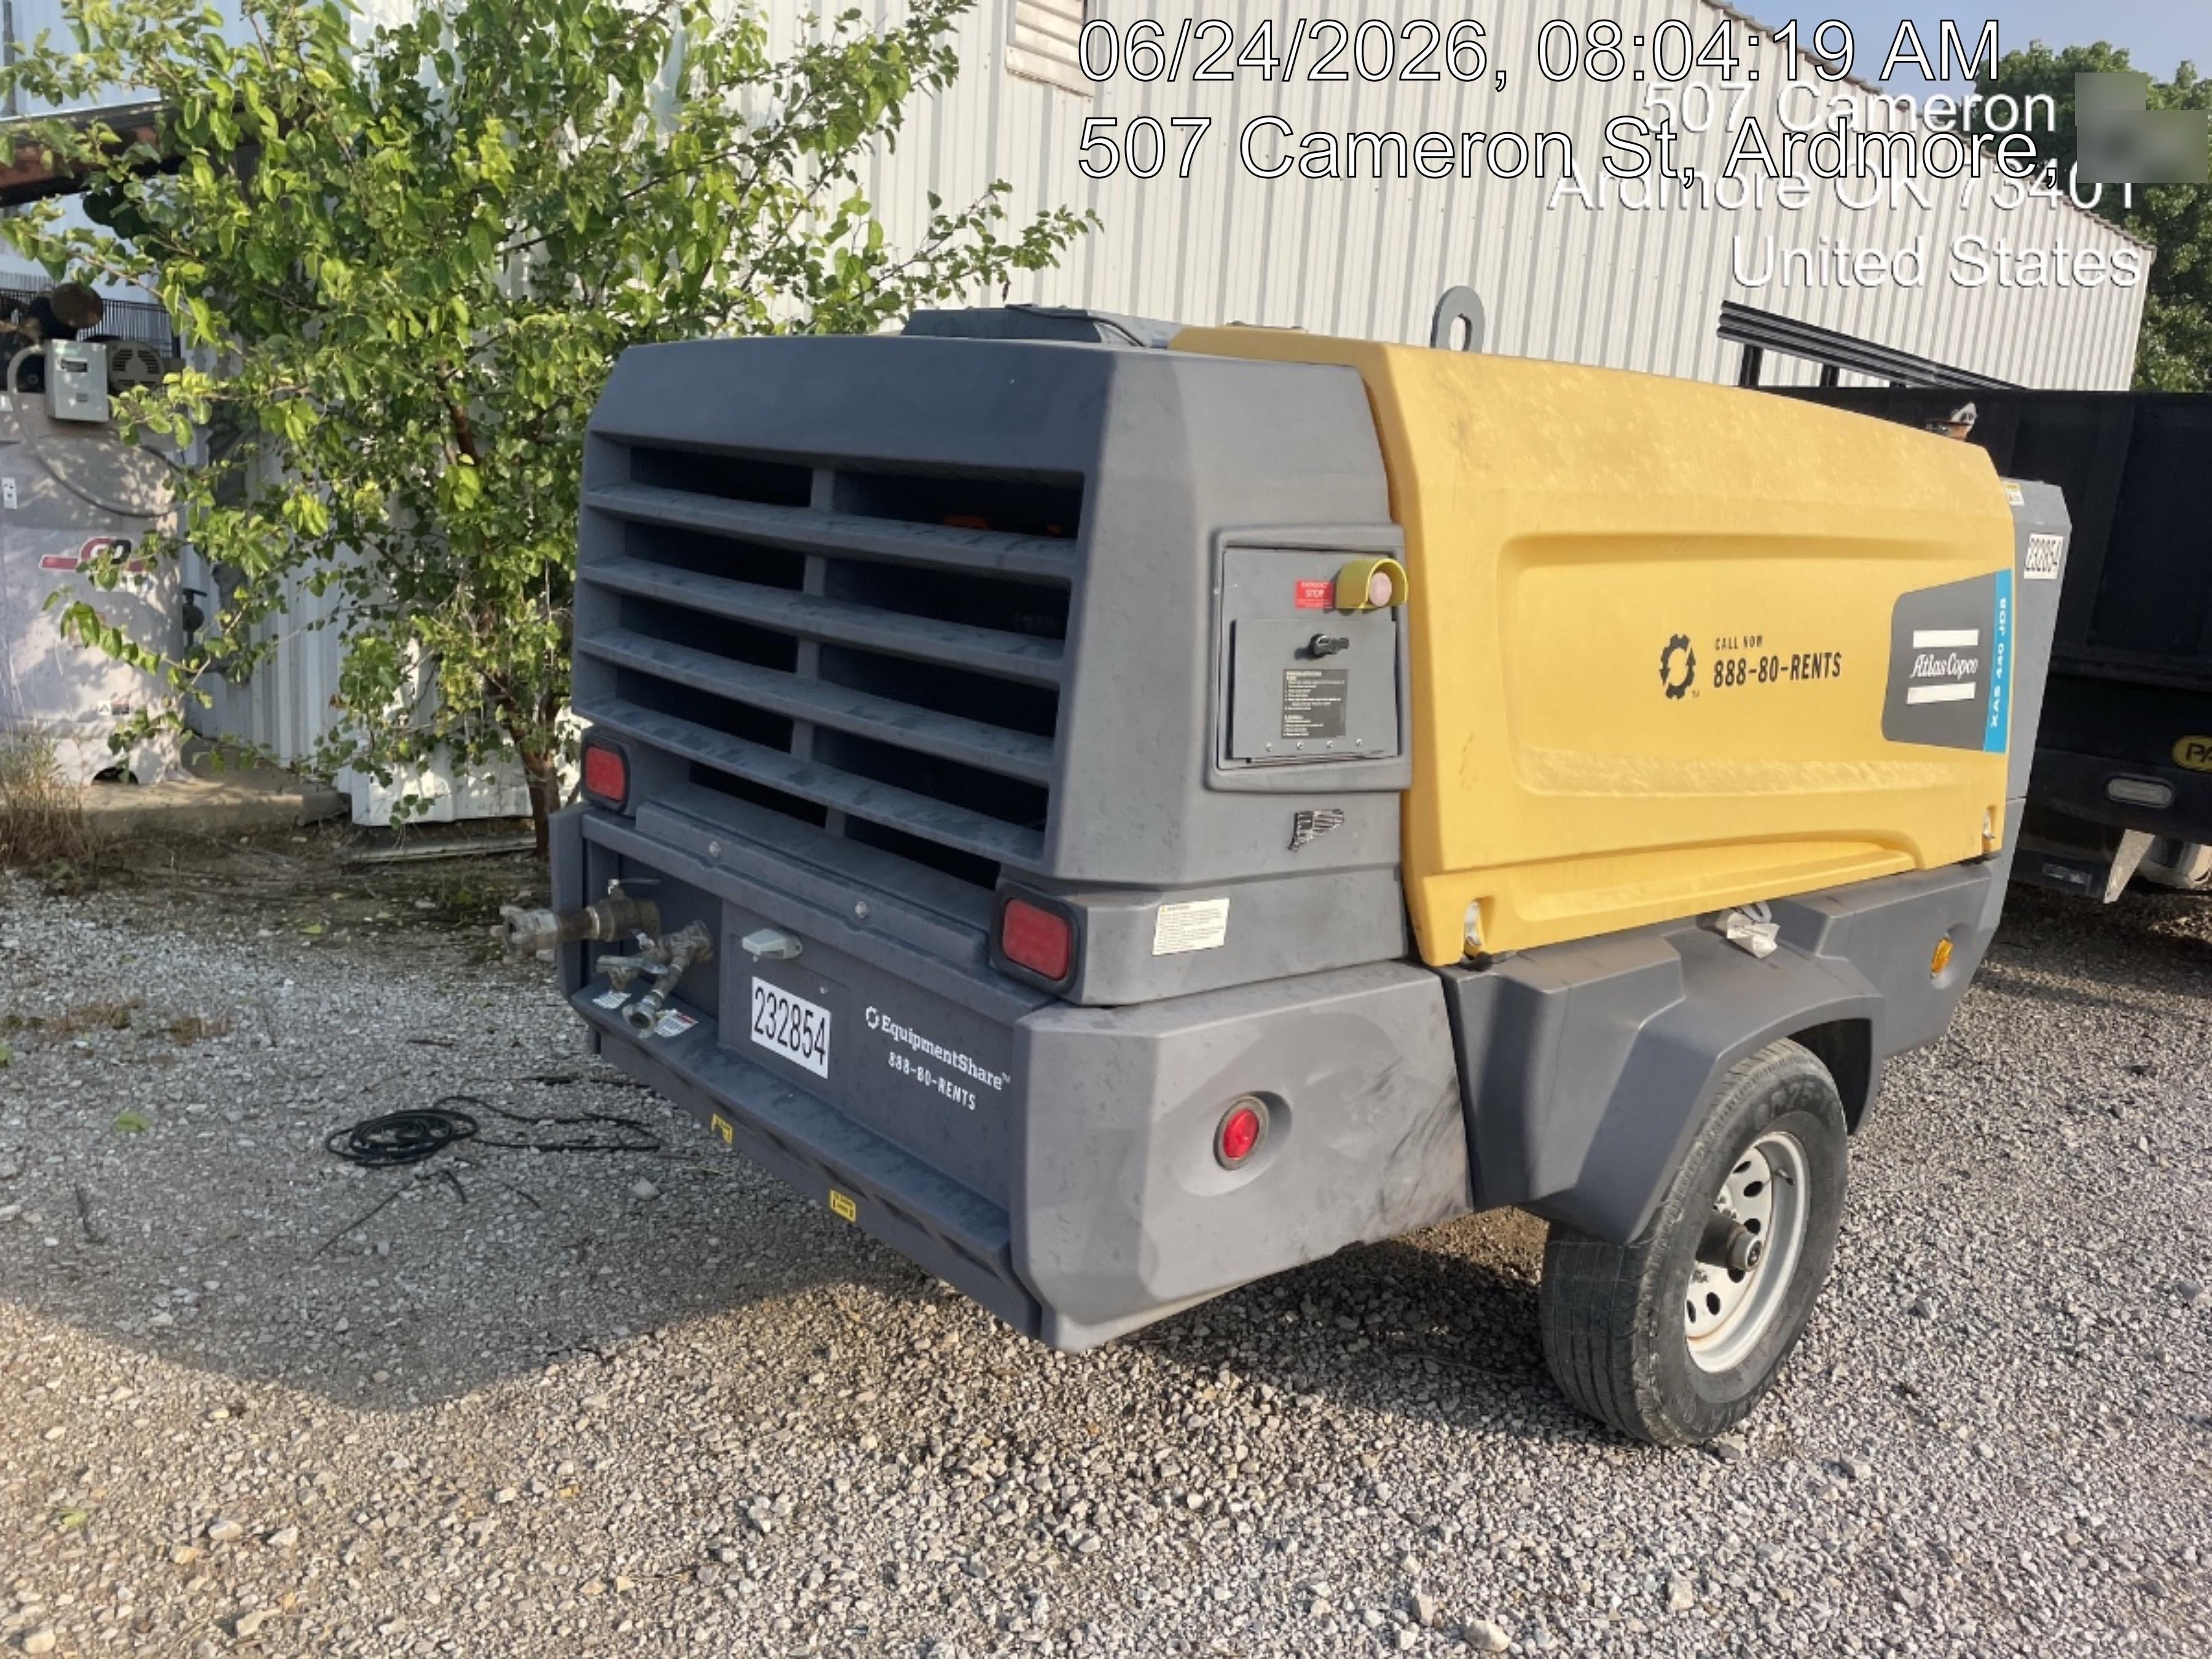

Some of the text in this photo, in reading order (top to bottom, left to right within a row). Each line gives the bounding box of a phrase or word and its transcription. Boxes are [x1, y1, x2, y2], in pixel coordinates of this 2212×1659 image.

[1715, 635, 1763, 651] CALL NOW
[1714, 652, 1842, 688] 888-80-RENTS
[1991, 685, 2001, 728] XAS
[753, 986, 826, 1066] 232854
[888, 1051, 976, 1111] 888-80-RENTS
